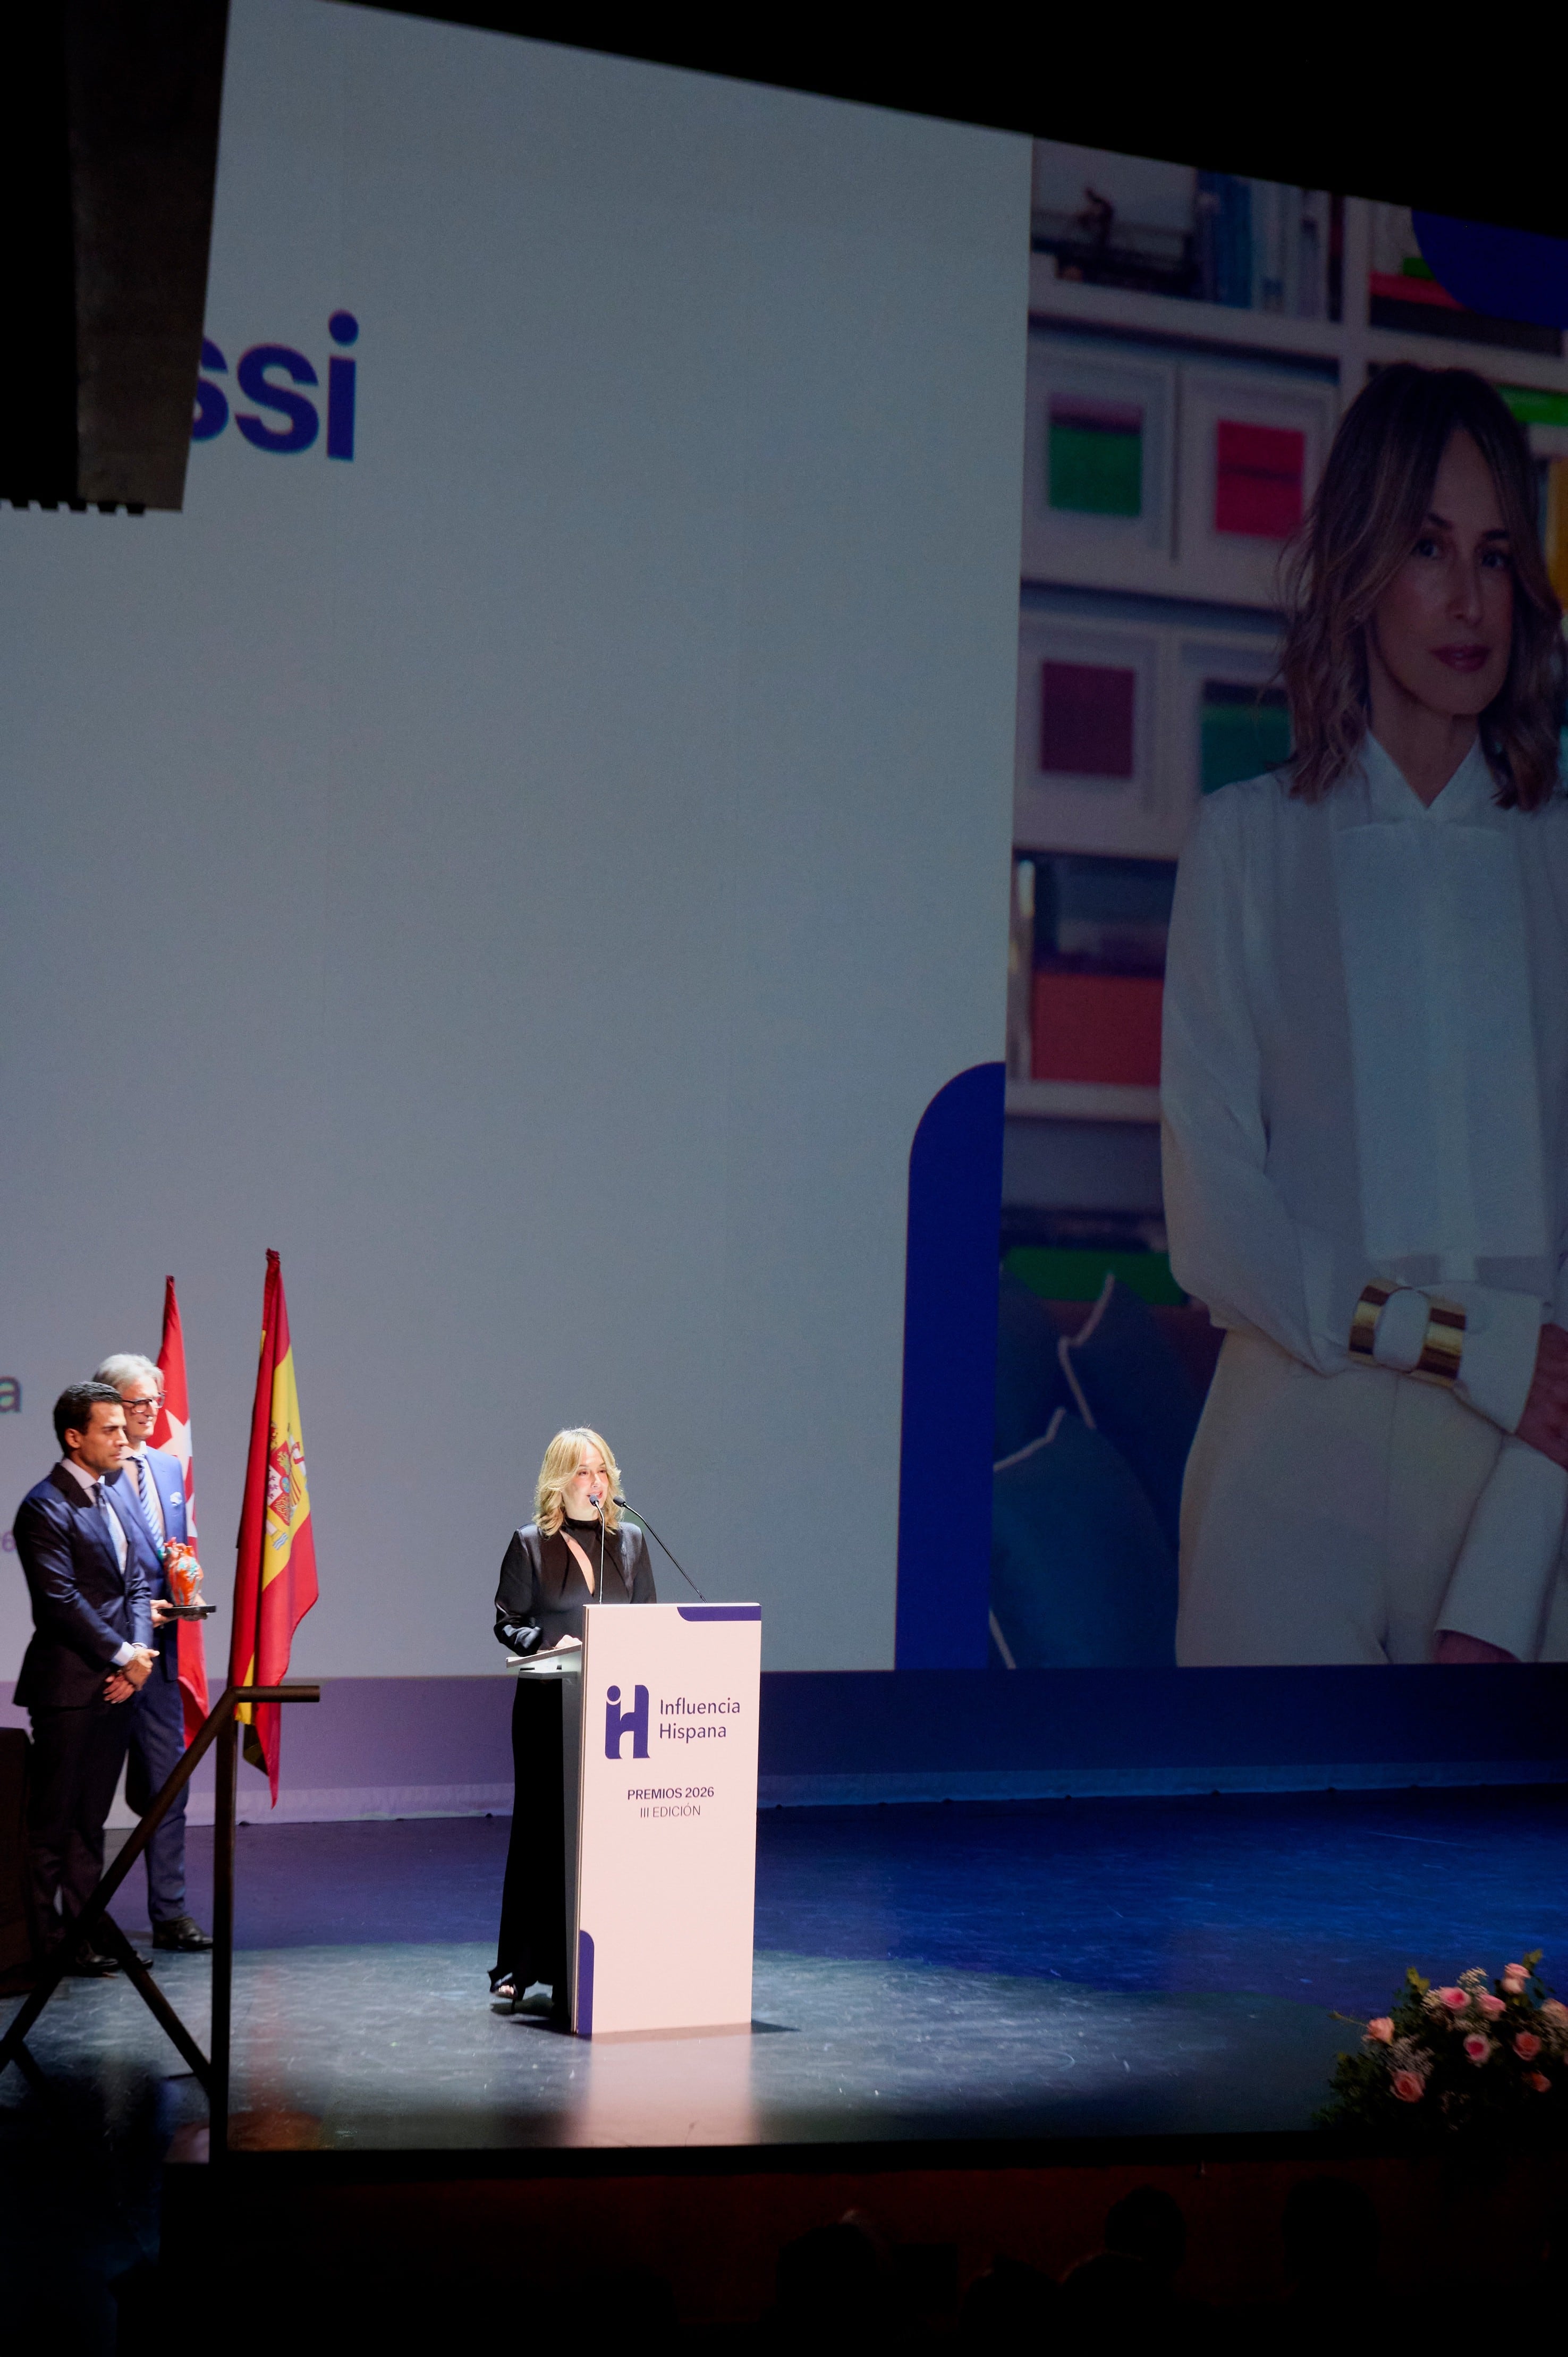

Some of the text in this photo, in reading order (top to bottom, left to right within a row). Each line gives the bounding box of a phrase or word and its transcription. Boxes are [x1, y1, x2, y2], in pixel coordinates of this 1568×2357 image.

[660, 1697, 741, 1715] Influencia
[659, 1722, 727, 1744] Hispana
[628, 1786, 715, 1800] PREMIOS 2026
[640, 1803, 701, 1819] III EDICIÓN
